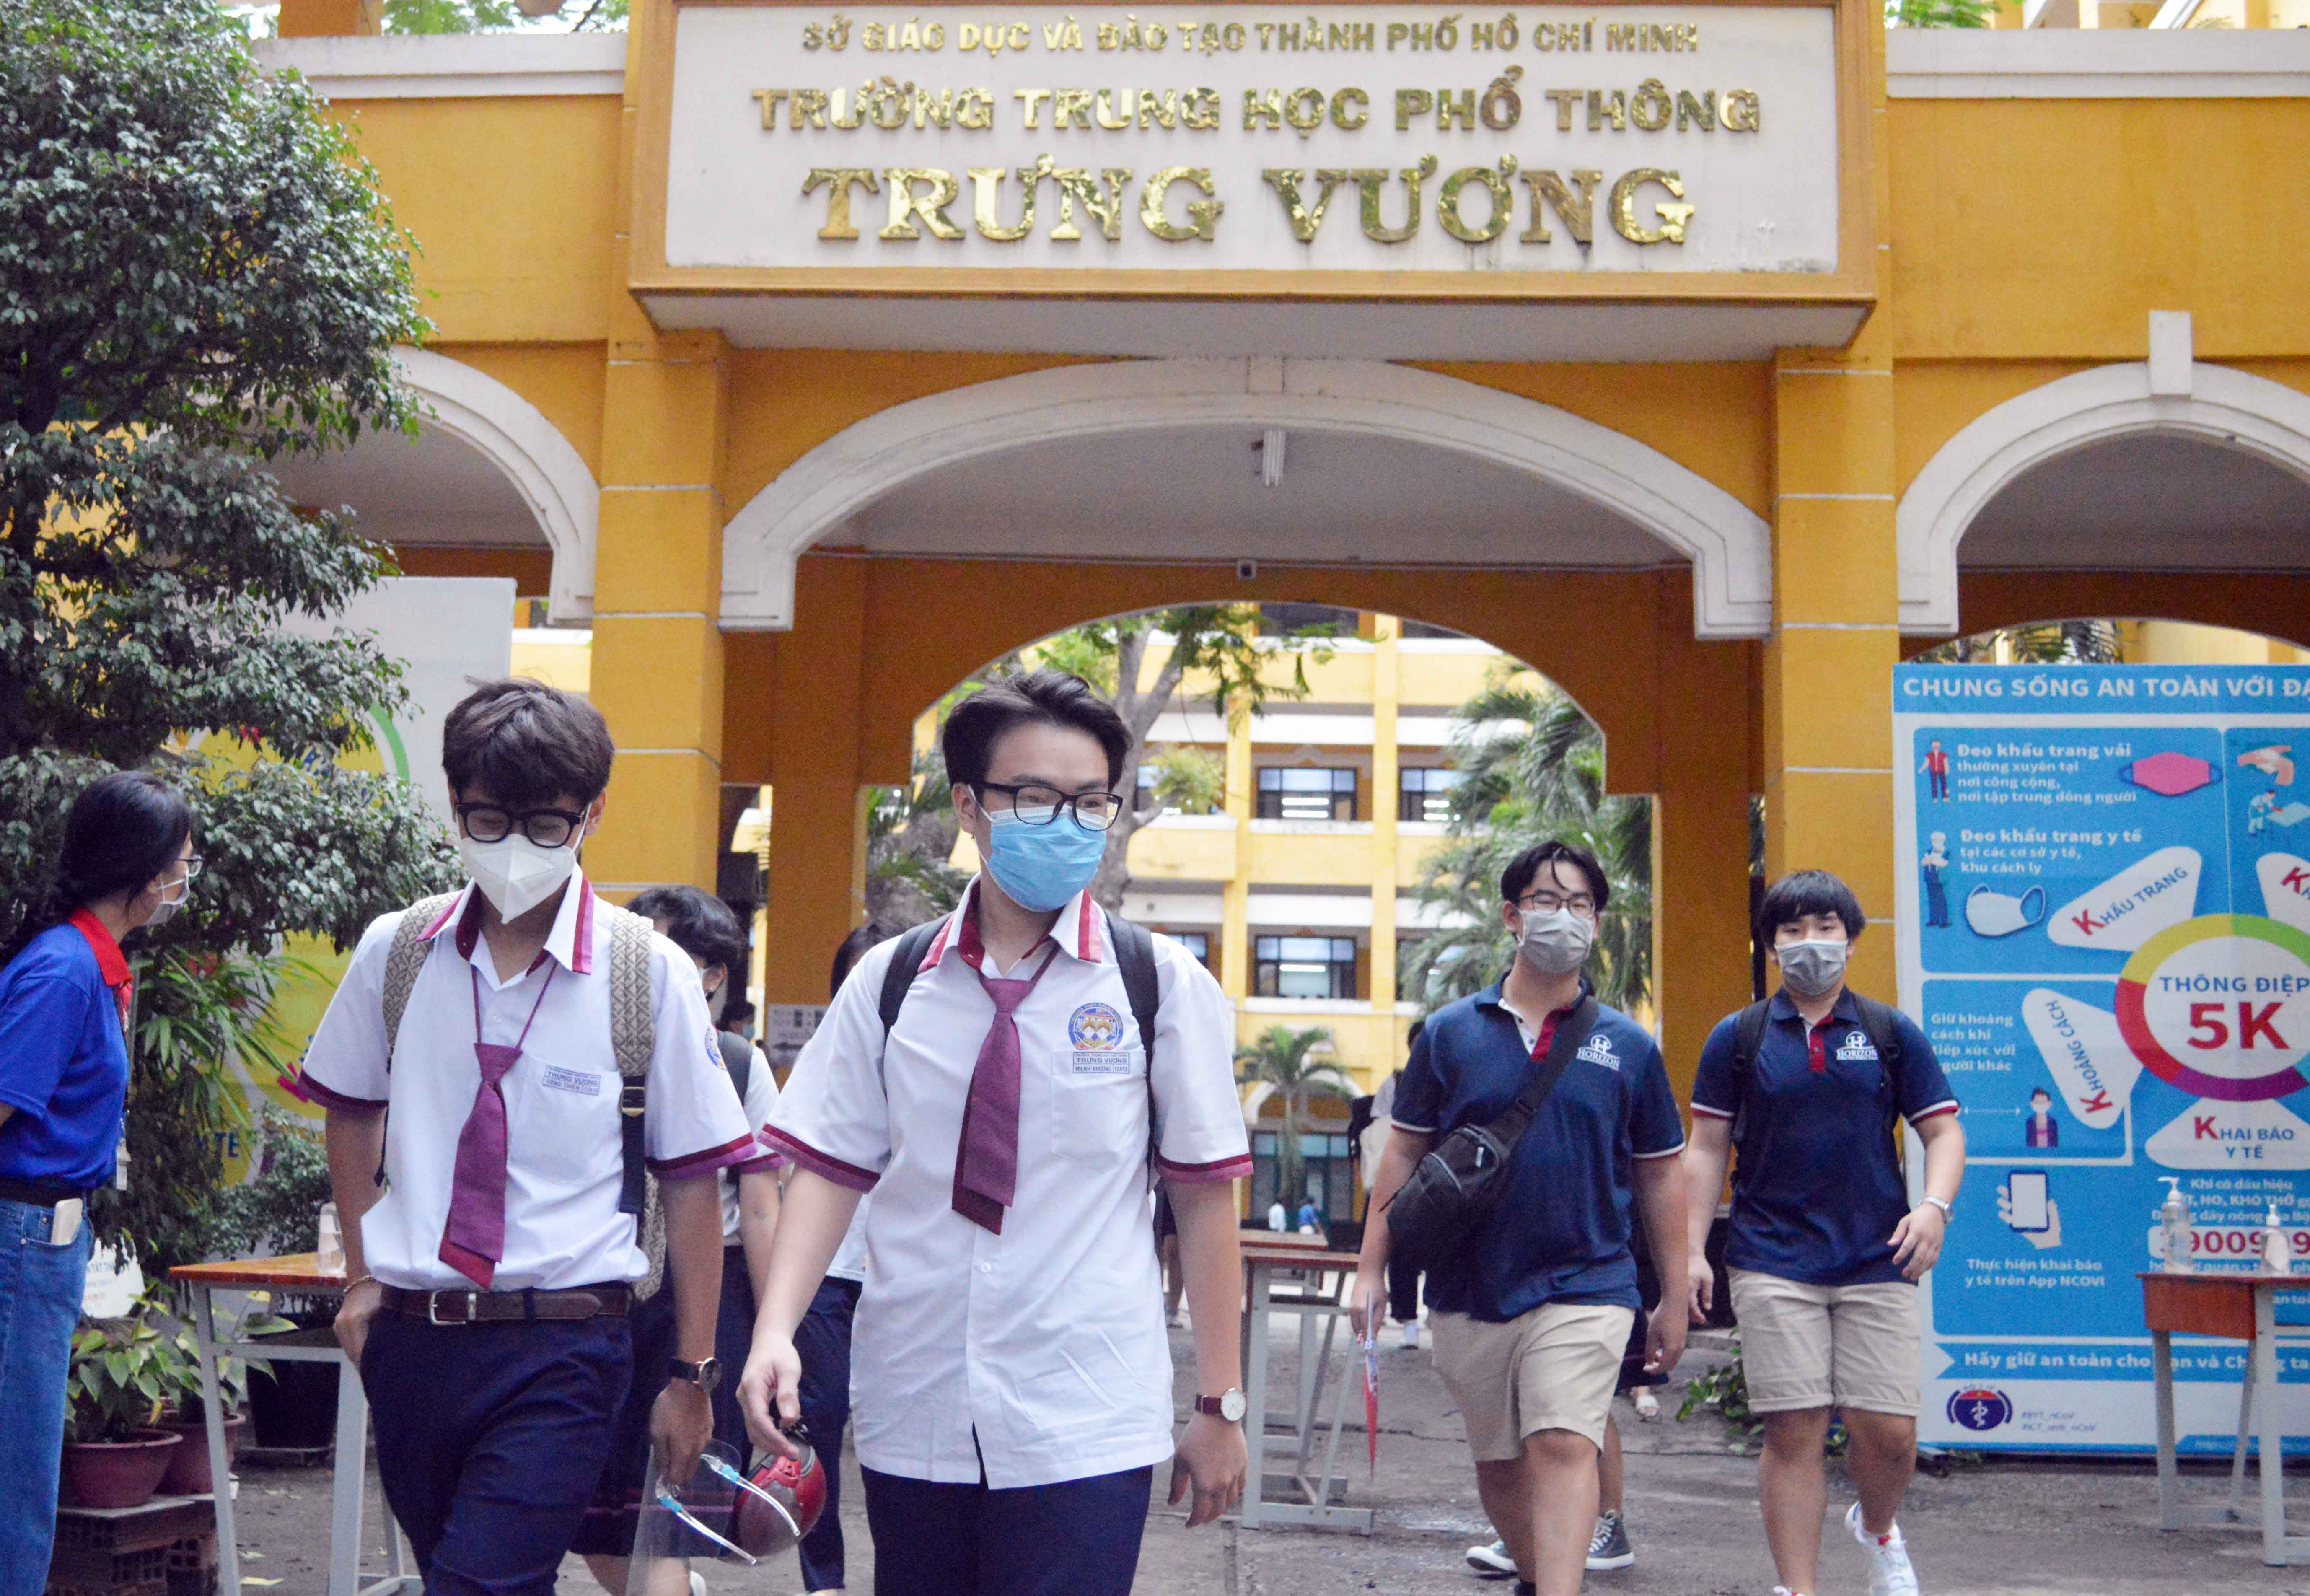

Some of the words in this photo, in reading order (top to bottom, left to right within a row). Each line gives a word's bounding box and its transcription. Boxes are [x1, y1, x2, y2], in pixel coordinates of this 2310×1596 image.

[803, 14, 853, 51] SỞ
[862, 17, 945, 51] GIÁO
[958, 22, 1031, 57] DỤC
[1041, 15, 1083, 51] VÀ
[1096, 13, 1168, 51] ĐÀO
[1177, 22, 1246, 55] TẠO
[1254, 17, 1374, 52] THÀNH
[1386, 13, 1463, 52] PHỐ
[1471, 13, 1520, 52] HỒ
[1533, 16, 1595, 52] CHÍ
[1606, 23, 1698, 52] MINH
[750, 75, 994, 130] TRƯỜNG
[1013, 86, 1220, 130] TRUNG
[1243, 87, 1370, 139] HỌC
[1395, 65, 1524, 131] PHỔ
[1546, 78, 1760, 132] THÔNG
[802, 153, 1225, 243] TRƯNG
[1261, 153, 1696, 244] VƯƠNG
[1903, 678, 2003, 697] CHUNG
[2011, 673, 2089, 697] SỐNG
[2096, 678, 2134, 697] AN
[2142, 675, 2218, 697] TOÀN
[2226, 675, 2273, 697] VỚI
[1957, 744, 1992, 757] Đeo
[2049, 745, 2099, 760] trang
[2012, 793, 2052, 805] trung
[1960, 829, 1996, 842] Đeo
[2053, 830, 2103, 846] trang
[2107, 832, 2118, 845] y
[2049, 848, 2059, 859] y
[1961, 861, 1988, 873] khu
[2133, 866, 2188, 903] TRANG
[2159, 974, 2247, 992] THÔNG
[2255, 974, 2310, 997] ĐIỆP
[2046, 1000, 2075, 1038] CÁCH
[2187, 1001, 2290, 1050] 5K
[1968, 1028, 1991, 1040] khi
[1577, 1048, 1621, 1070] HORIZON
[1836, 1049, 1878, 1060] HORIZON
[1940, 1060, 1974, 1074] gười
[2194, 1116, 2251, 1140] KHAI
[2257, 1125, 2295, 1140] BÁO
[2226, 1146, 2235, 1158] Y
[2191, 1179, 2214, 1189] Khi
[2040, 1258, 2072, 1270] khai
[1965, 1276, 1974, 1288] y
[2028, 1275, 2057, 1289] App
[1964, 1352, 2001, 1368] Hãy
[2041, 1355, 2063, 1367] an
[2068, 1353, 2112, 1368] toàn
[2116, 1353, 2151, 1368] cho
[2171, 1357, 2192, 1372] ạn
[2196, 1355, 2219, 1368] và
[2290, 1357, 2309, 1369] ta
